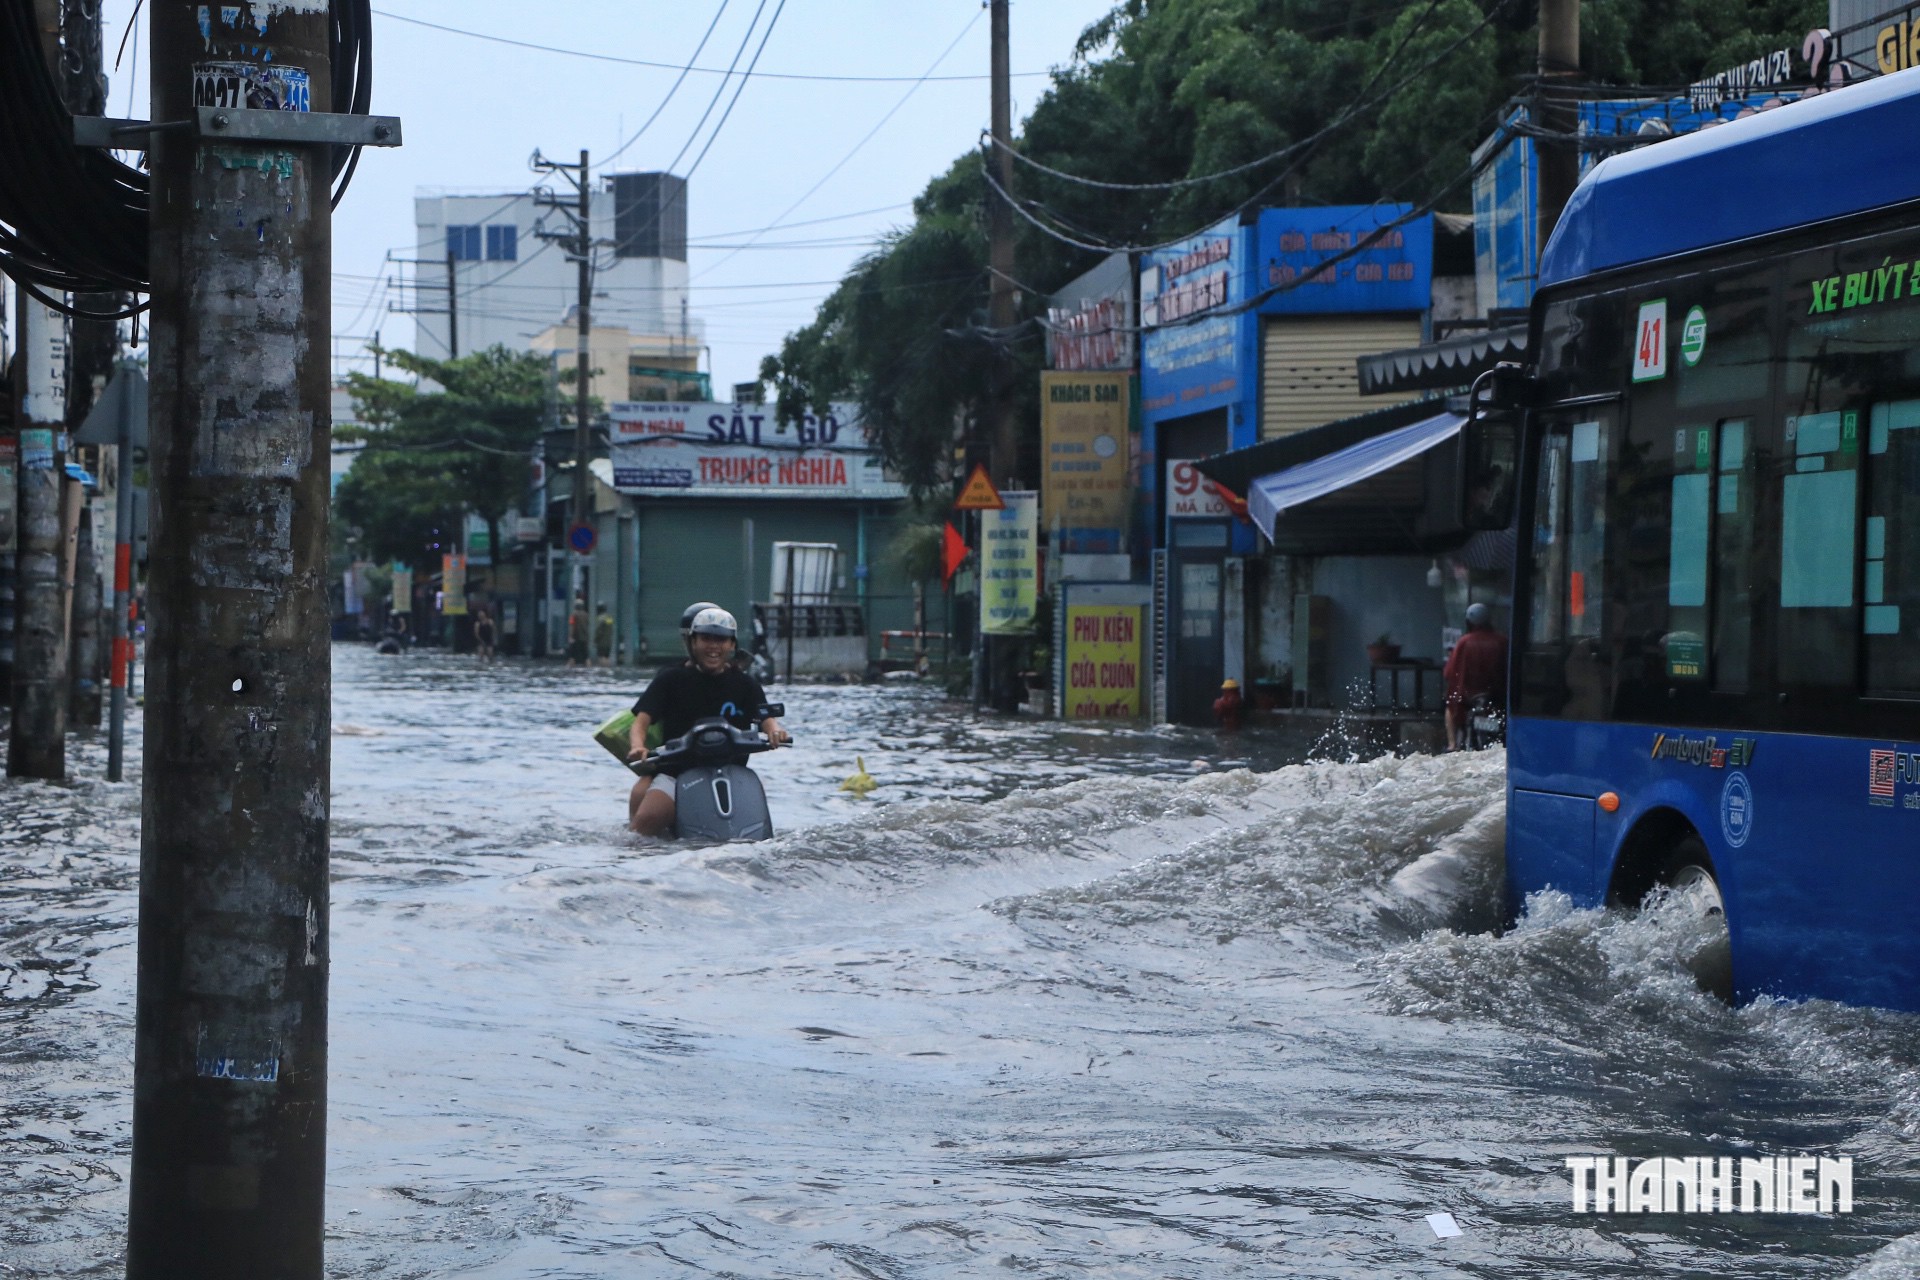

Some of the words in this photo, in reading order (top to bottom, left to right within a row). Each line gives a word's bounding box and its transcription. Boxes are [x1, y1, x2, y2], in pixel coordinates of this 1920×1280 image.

[1749, 49, 1790, 86] 24/24
[1808, 277, 1840, 315] XE
[1842, 256, 1909, 308] BUÝT
[1639, 318, 1661, 368] 41
[1051, 381, 1090, 402] KHÁCH
[708, 404, 764, 445] SẮT
[698, 457, 770, 485] TRUNG
[777, 452, 847, 485] NGHĨA
[1176, 498, 1197, 513] MÃ
[1075, 616, 1099, 648] PHỤ
[1103, 611, 1134, 648] KIỆN
[1071, 653, 1096, 688] CỬA
[1101, 655, 1135, 688] CUỐN
